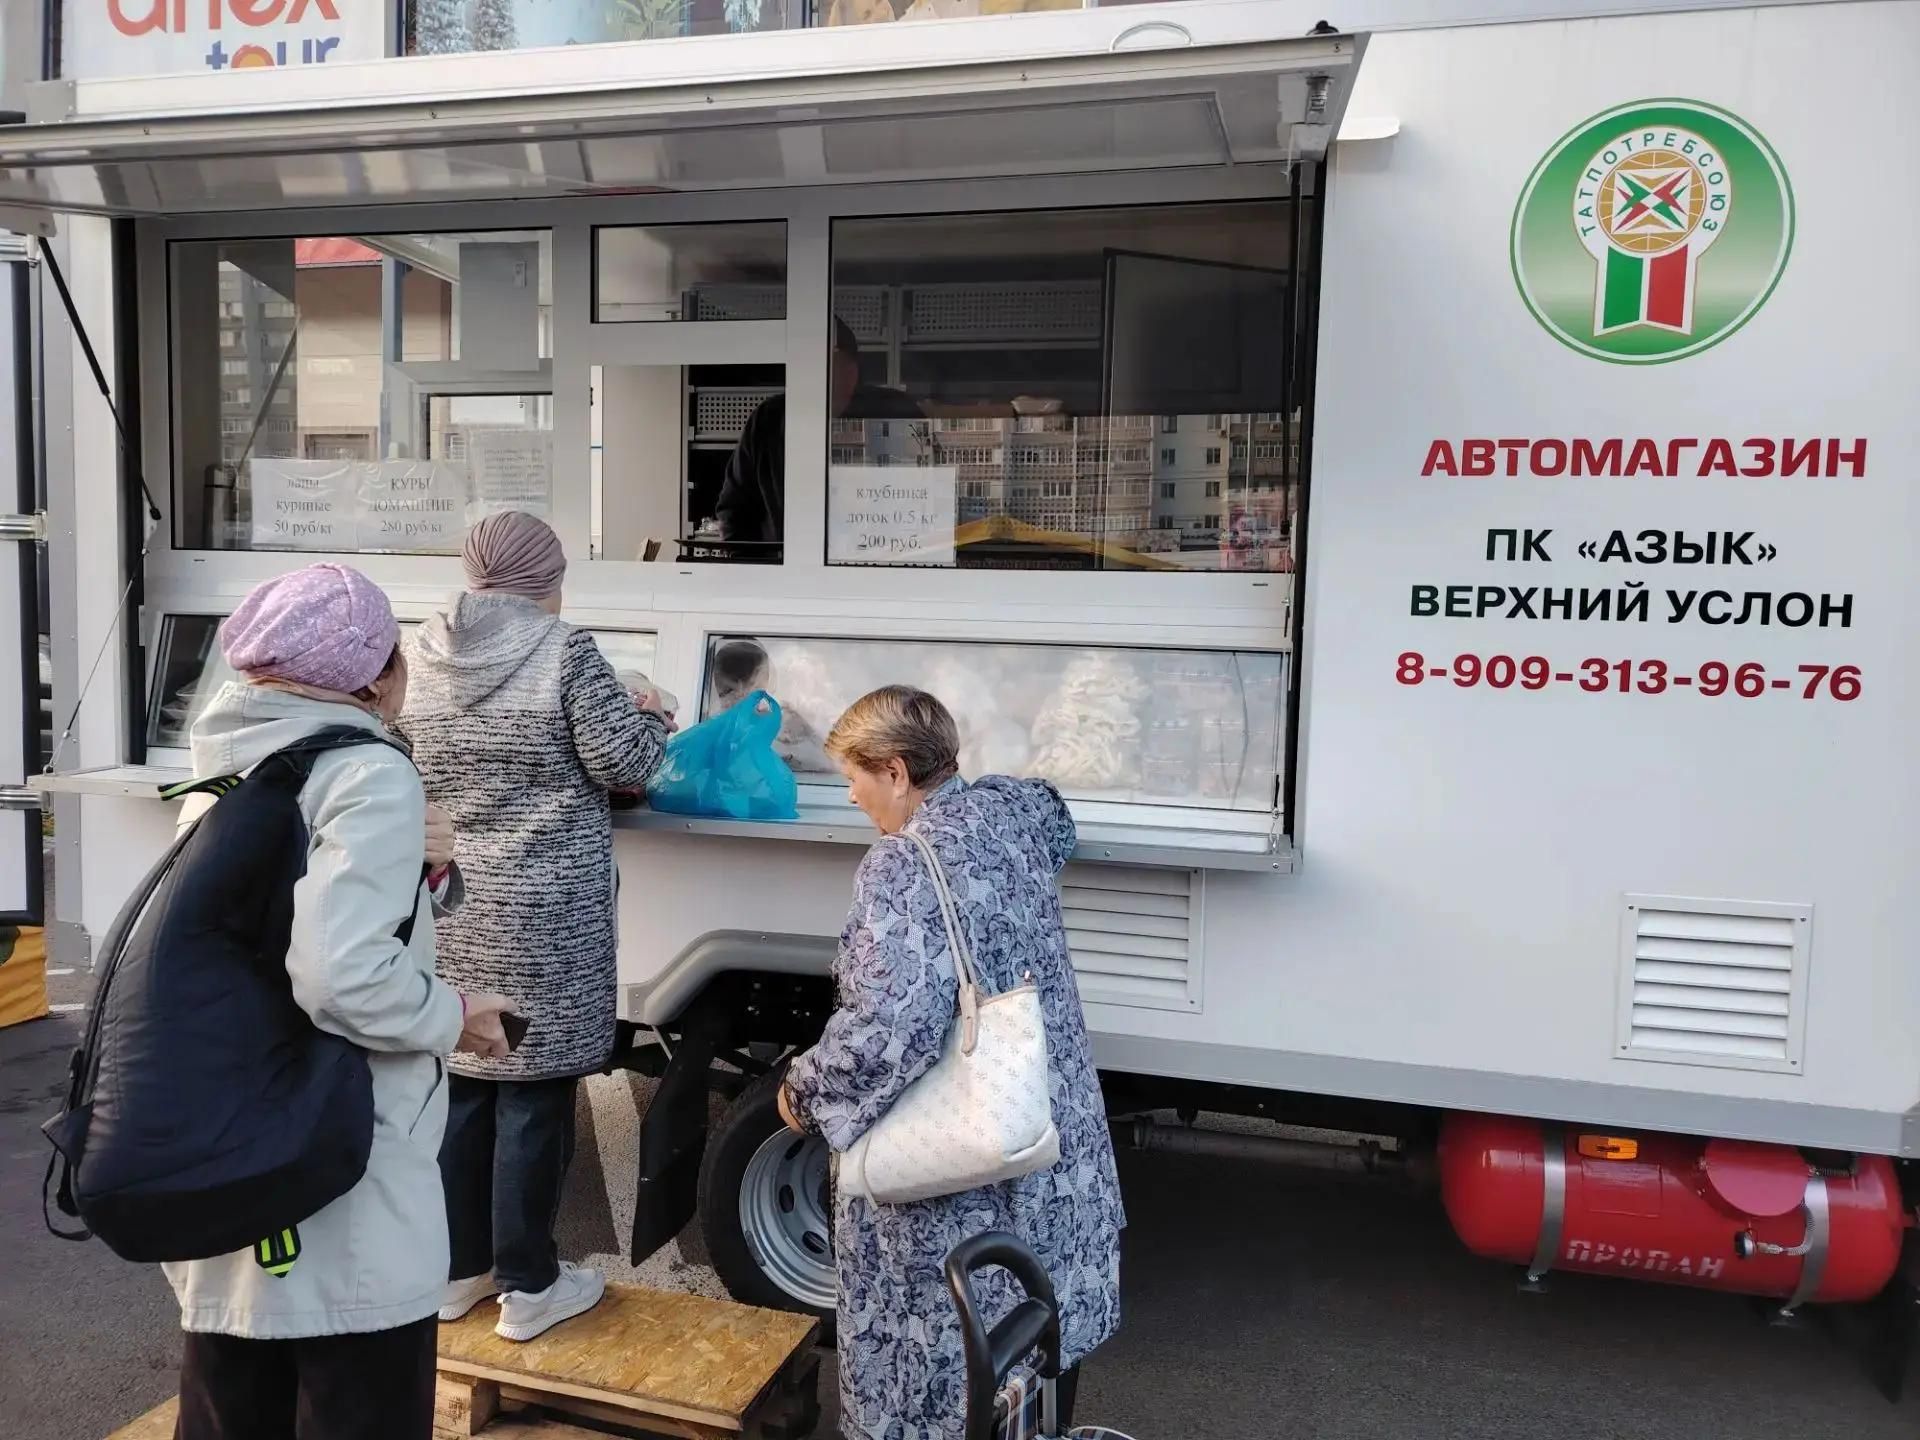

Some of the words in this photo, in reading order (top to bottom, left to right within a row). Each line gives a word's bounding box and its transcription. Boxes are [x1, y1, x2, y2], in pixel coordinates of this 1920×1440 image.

[1579, 132, 1727, 237] ТАТПОТРЕБСОЮЗ
[1421, 438, 1868, 478] АВТОМАГАЗИН
[391, 478, 431, 491] КУРЫ
[856, 485, 929, 502] клубника
[276, 500, 332, 513] куриные
[368, 500, 455, 513] ДОМАШНИЕ
[381, 520, 402, 533] 280
[846, 513, 889, 524] лоток
[921, 513, 939, 525] кг
[274, 520, 289, 532] 50
[292, 520, 334, 536] руб/кг
[857, 534, 886, 551] 200
[890, 535, 922, 552] руб.
[1485, 528, 1554, 562] ПК
[1577, 530, 1777, 565] «АЗЫК»
[1410, 580, 1650, 622] ВЕРХНИЙ
[1666, 589, 1854, 628] УСЛОН
[1395, 651, 1863, 701] 8-909-313-96-76
[1565, 1239, 1726, 1279] ПРОПАН
